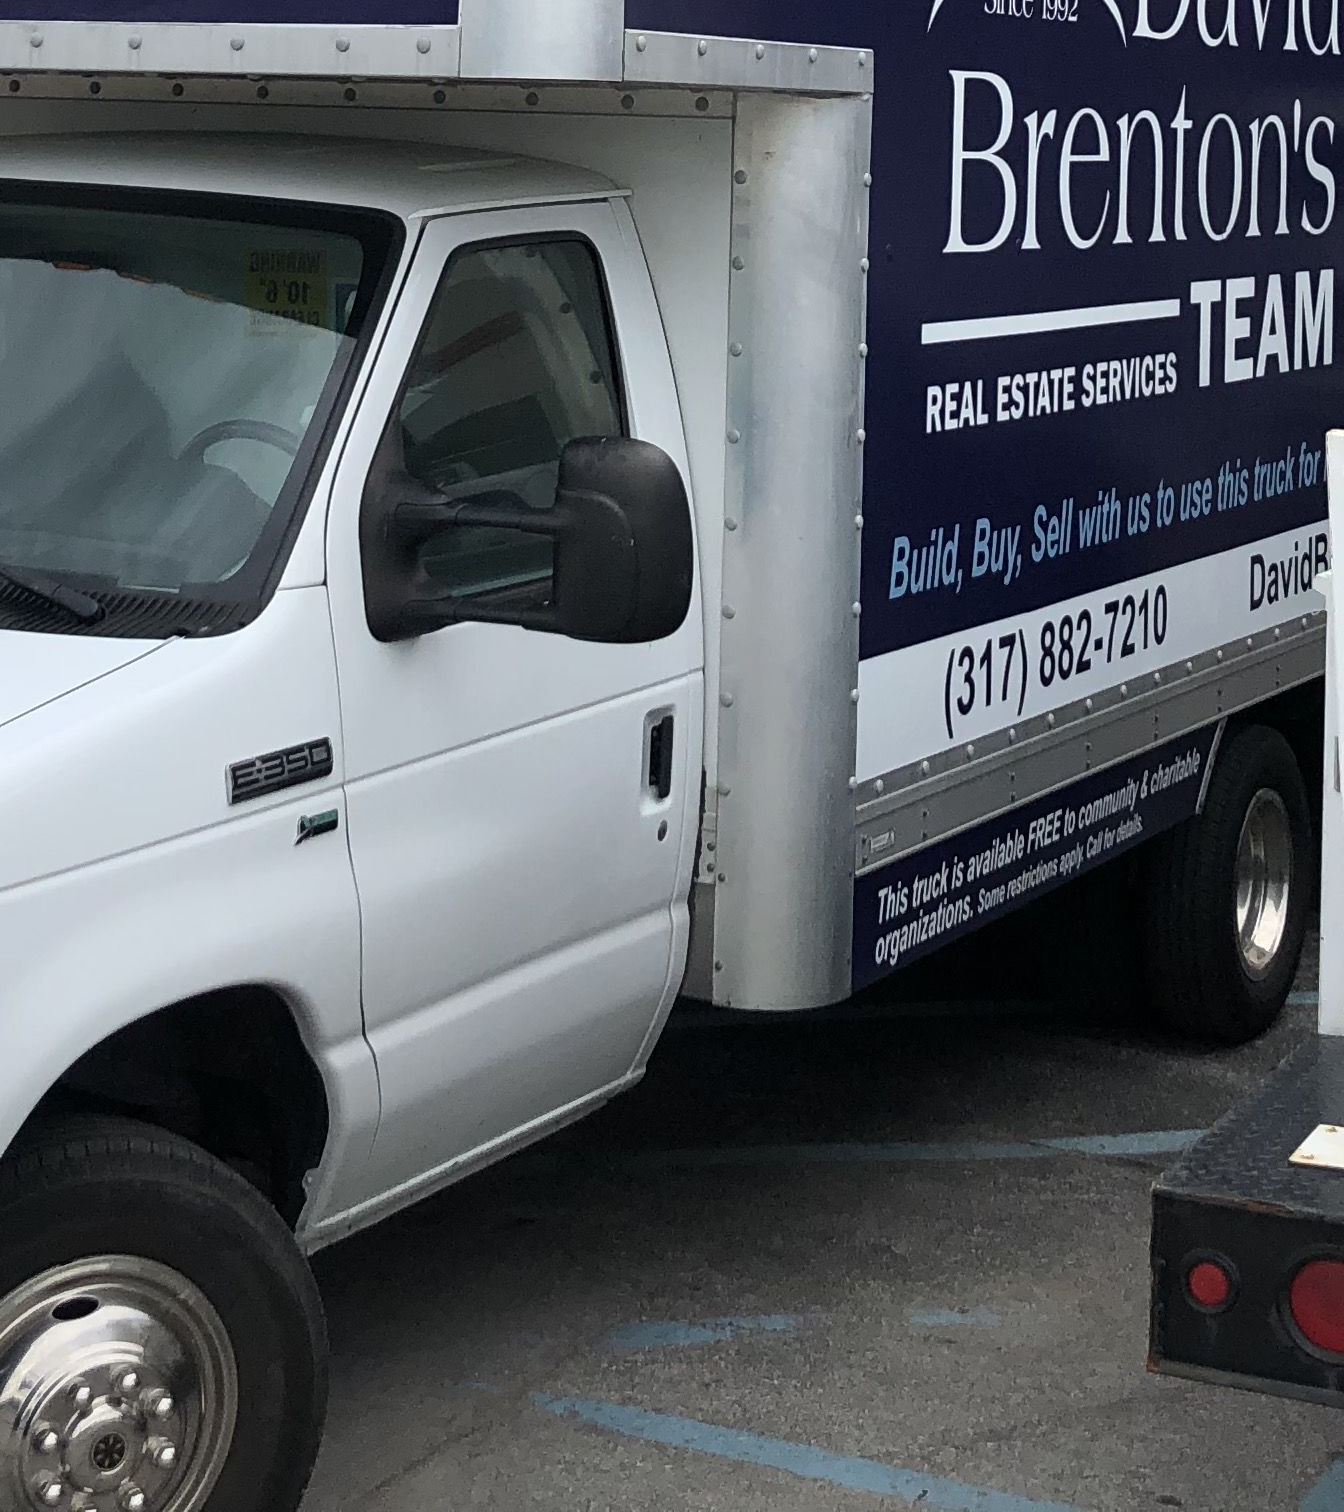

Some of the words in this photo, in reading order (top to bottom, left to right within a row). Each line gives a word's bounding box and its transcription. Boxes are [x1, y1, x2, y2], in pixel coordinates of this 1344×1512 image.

[942, 68, 1337, 254] Brenton's
[926, 379, 989, 434] REAL
[996, 366, 1076, 423] ESTATE
[1081, 352, 1177, 408] SERVICES
[1190, 268, 1335, 388] TEAM
[888, 523, 964, 600] Build,
[971, 518, 1022, 586] Buy,
[1031, 496, 1074, 563] Sell
[1078, 486, 1122, 550] with
[1127, 491, 1151, 537] us
[1156, 477, 1175, 529] to
[1180, 476, 1213, 523] use
[1217, 457, 1249, 513] this
[1253, 444, 1295, 502] truck
[1298, 441, 1322, 489] for
[945, 628, 1028, 740] (317)
[1039, 584, 1168, 688] 882-7210
[875, 894, 974, 967] organizations.
[977, 884, 1006, 914] Some
[1007, 857, 1058, 900] restrictions
[1086, 830, 1103, 859] Call
[1103, 828, 1116, 850] for
[878, 881, 908, 924] This
[912, 861, 949, 908] truck
[951, 856, 965, 889] is
[966, 828, 1025, 882] available
[1027, 809, 1062, 855] FREE
[1064, 808, 1076, 837] to
[1078, 778, 1139, 830] community
[1140, 769, 1149, 799] &
[1150, 747, 1201, 794] charitable
